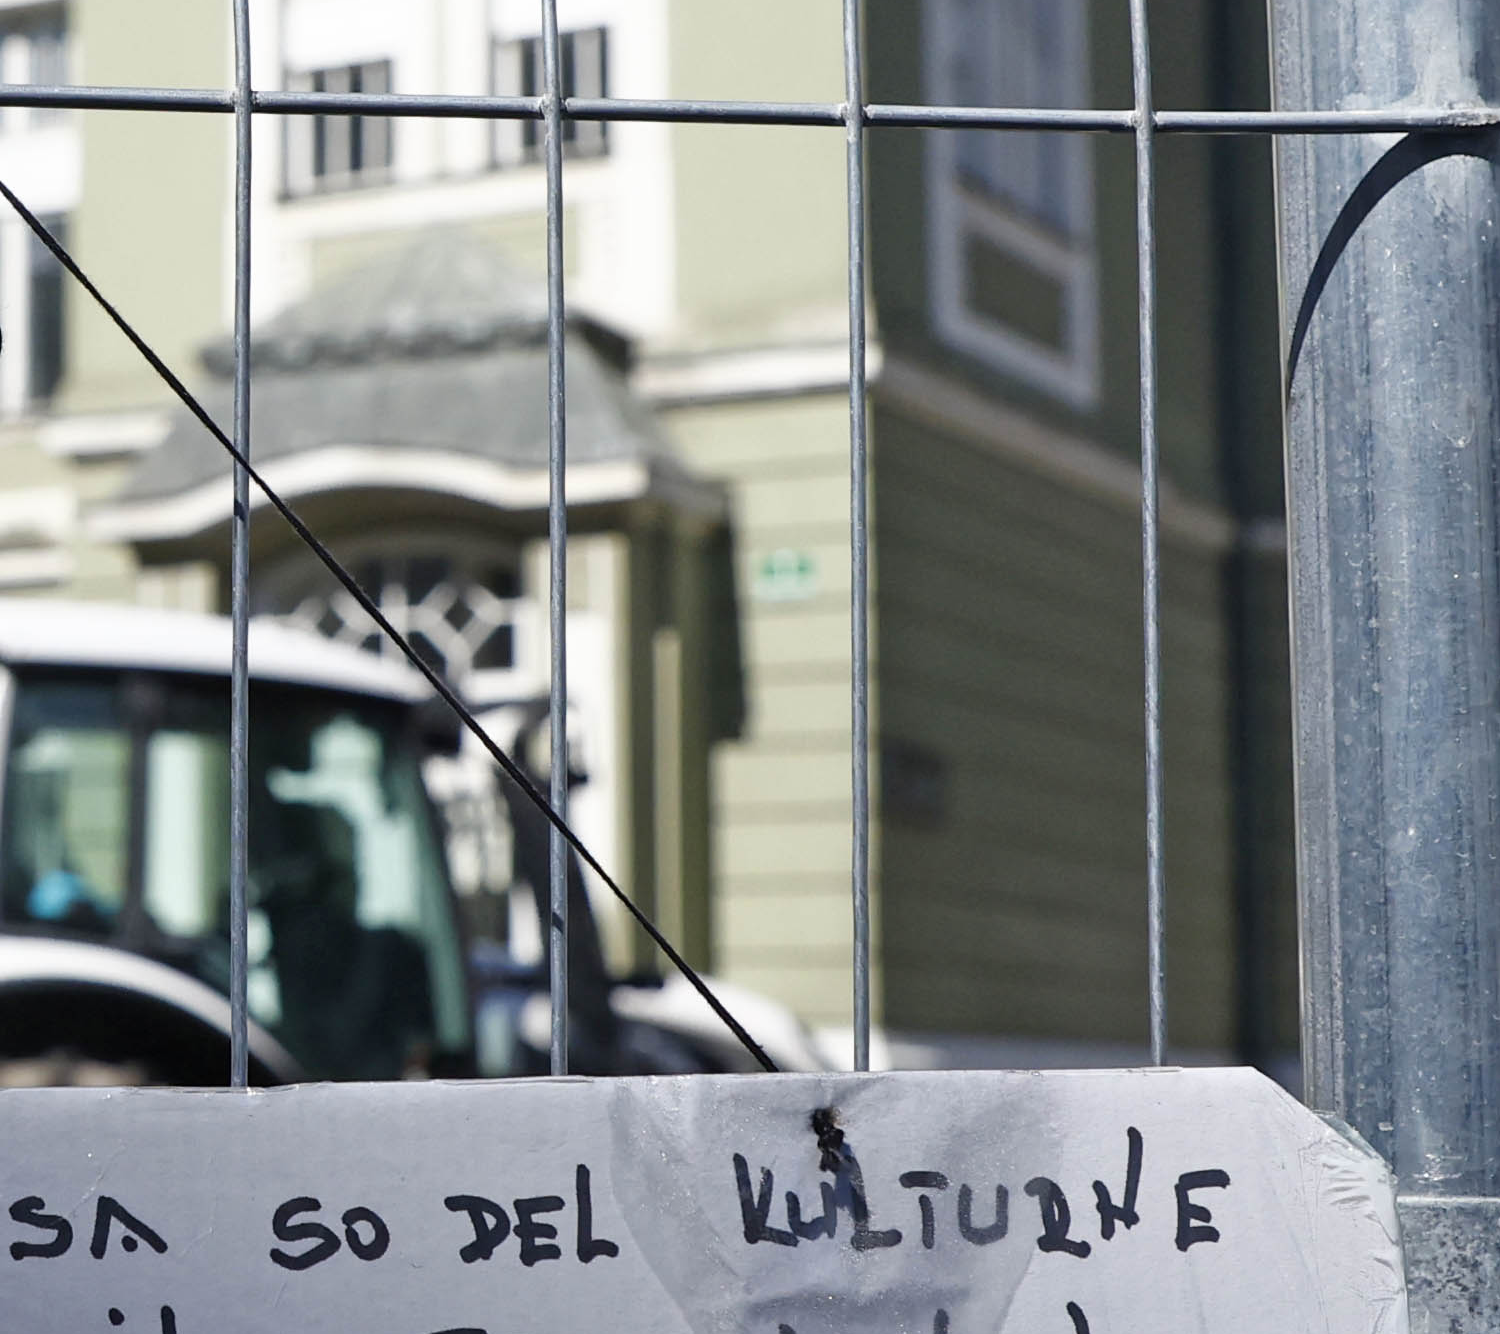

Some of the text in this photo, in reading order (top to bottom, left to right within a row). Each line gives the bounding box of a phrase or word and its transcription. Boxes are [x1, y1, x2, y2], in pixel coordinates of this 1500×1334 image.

[270, 1196, 390, 1270] SO
[445, 1164, 619, 1265] DEL
[731, 1127, 1231, 1258] KULTURNE
